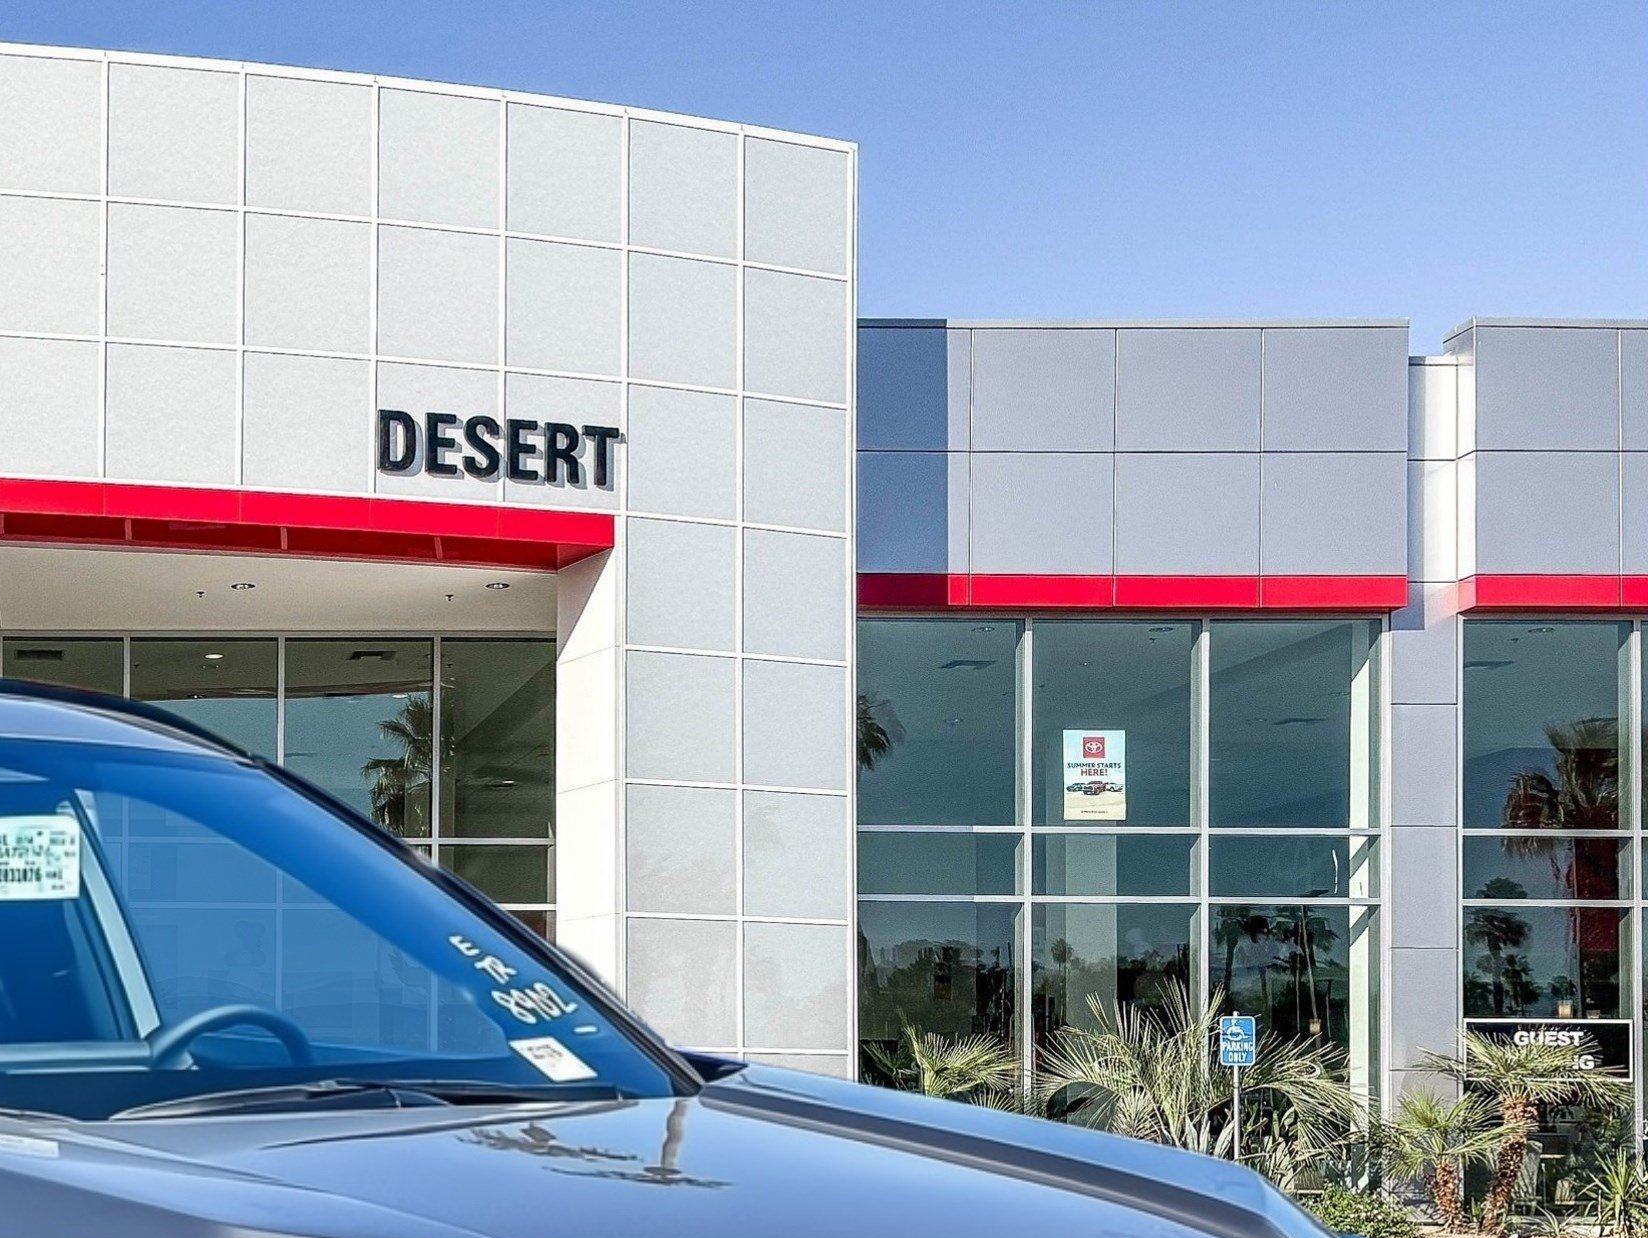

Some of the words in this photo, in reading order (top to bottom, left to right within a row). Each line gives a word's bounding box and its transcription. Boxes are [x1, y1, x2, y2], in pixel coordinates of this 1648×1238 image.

[377, 409, 620, 487] DESERT
[1080, 768, 1108, 776] HERE!
[1513, 1031, 1585, 1047] GUEST
[1222, 1041, 1253, 1052] PARKING
[1228, 1052, 1247, 1062] ONLY
